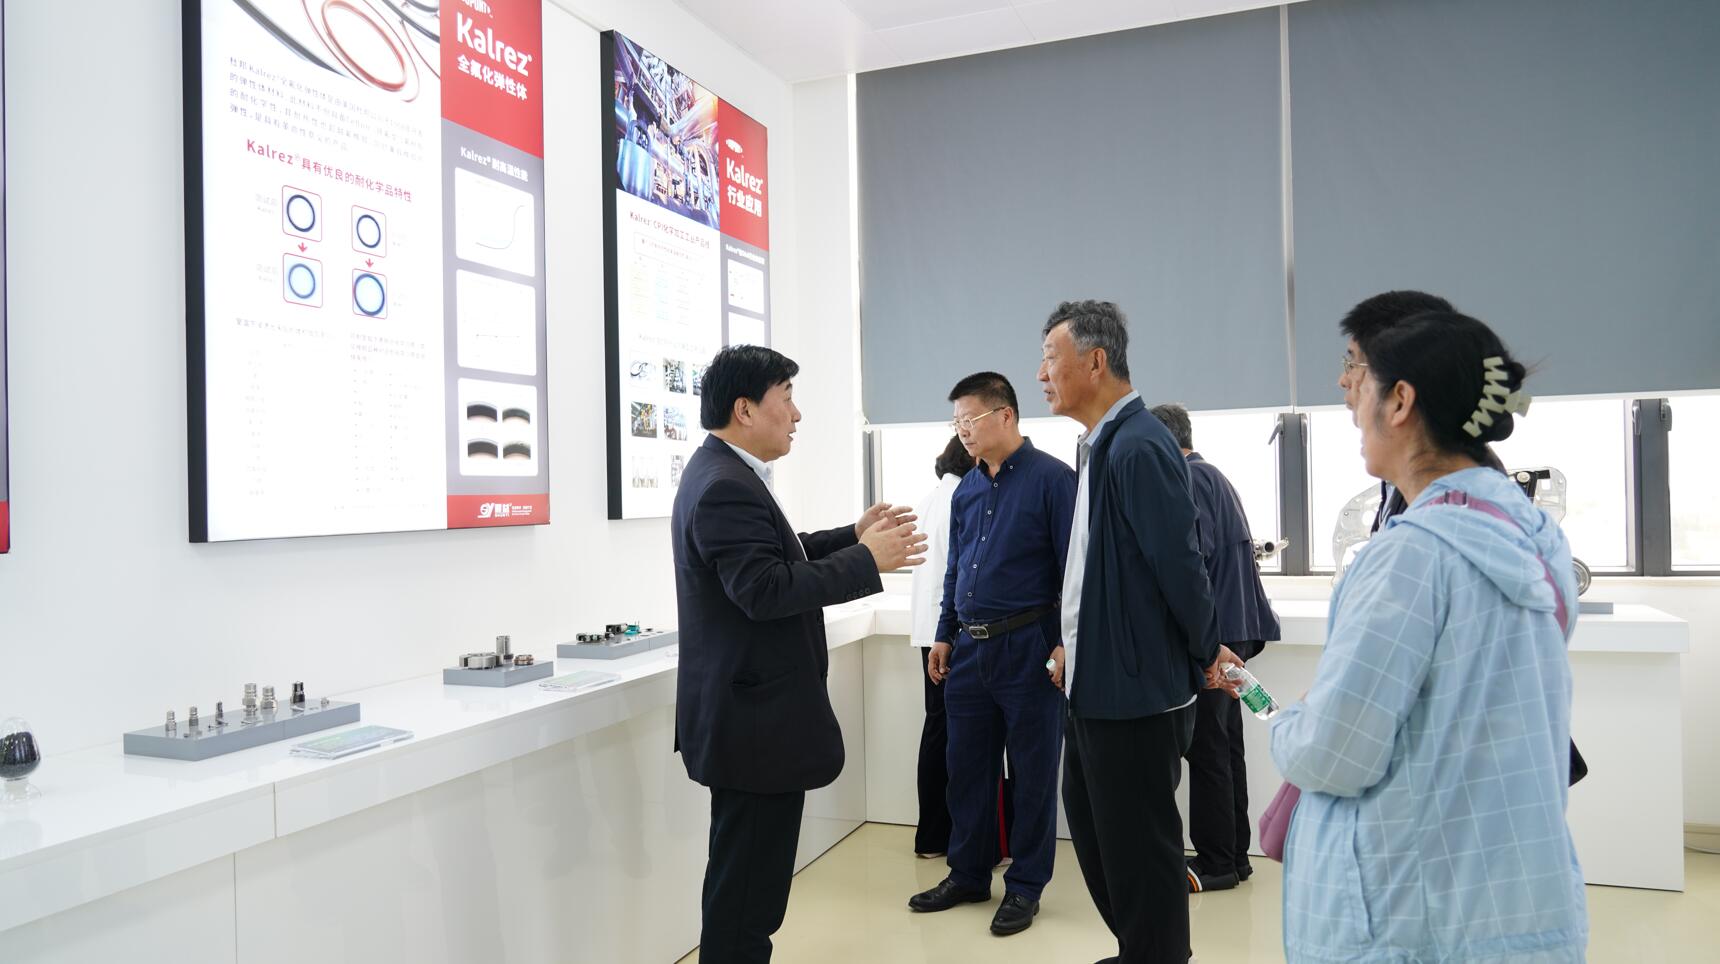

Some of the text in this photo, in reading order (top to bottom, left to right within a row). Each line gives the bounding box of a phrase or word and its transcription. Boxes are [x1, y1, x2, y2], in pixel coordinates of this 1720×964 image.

[457, 54, 528, 101] 全氟化弹性体
[727, 184, 762, 217] 行业应用
